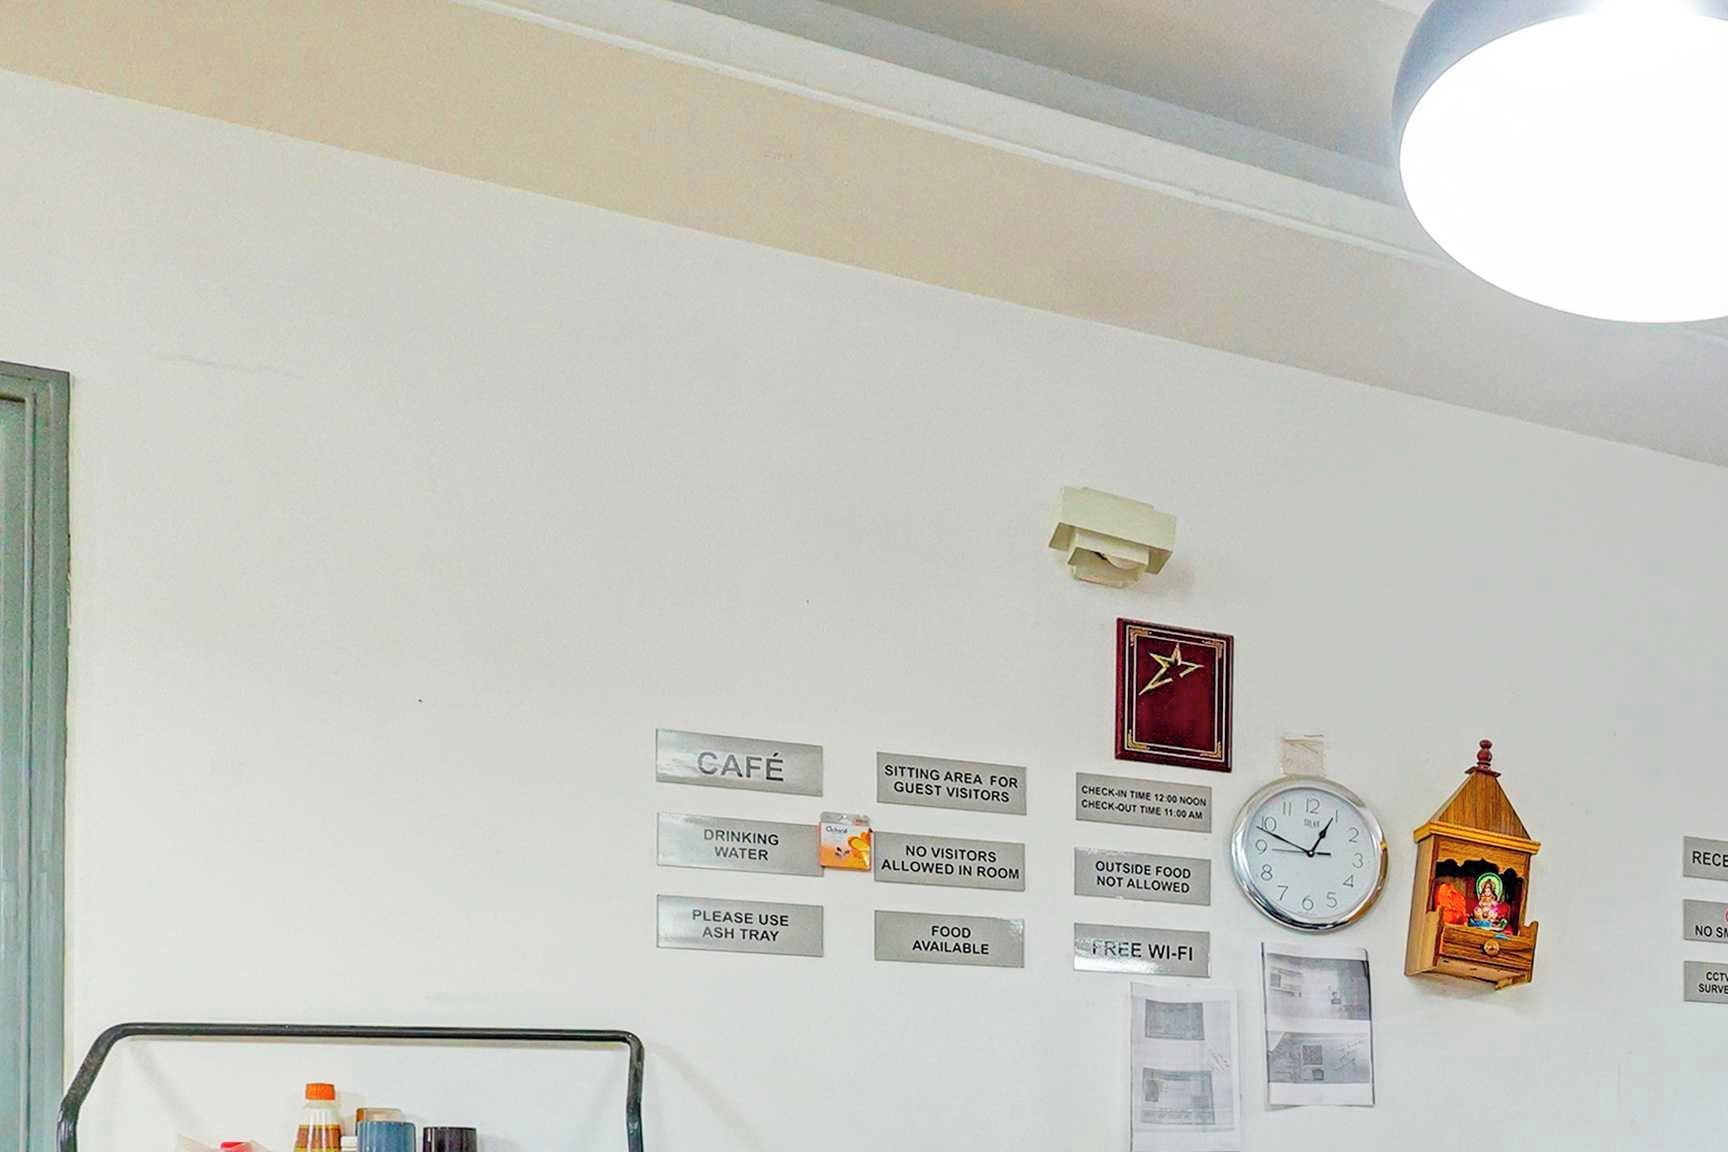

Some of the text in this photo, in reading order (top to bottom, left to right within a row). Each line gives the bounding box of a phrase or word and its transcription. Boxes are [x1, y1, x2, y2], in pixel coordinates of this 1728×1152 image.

[698, 752, 784, 782] CAFÉ
[885, 764, 1018, 789] SITTING AREA FOR
[894, 781, 1010, 802] GUEST VISITORS
[1081, 785, 1127, 798] CHECK-IN
[1130, 791, 1151, 800] TIME
[1180, 796, 1206, 806] NOON
[1081, 799, 1202, 819] CHECK-OUT TIME 11:00 AM
[1283, 802, 1291, 816] 11
[1306, 798, 1320, 814] 12
[704, 828, 779, 846] DRINKING
[1349, 827, 1359, 843] 2
[715, 846, 769, 861] WATER
[906, 845, 997, 863] NO VISITORS
[1255, 839, 1267, 855] 9
[1352, 853, 1363, 868] 3
[881, 859, 1019, 879] ALLOWED IN ROOM
[1096, 861, 1191, 879] OUTSIDE FOOD
[1261, 864, 1272, 880] 8
[1096, 876, 1190, 893] NOT ALLOWED
[1343, 875, 1354, 888] 4
[1278, 885, 1288, 900] 7
[1327, 892, 1337, 908] 5
[1302, 895, 1313, 911] 6
[693, 909, 789, 927] PLEASE USE
[703, 926, 780, 942] ASH TRAY
[931, 926, 971, 939] FOOD
[1695, 925, 1712, 937] NO
[912, 941, 990, 955] AVAILABLE
[1092, 941, 1193, 961] FREE WI-FI
